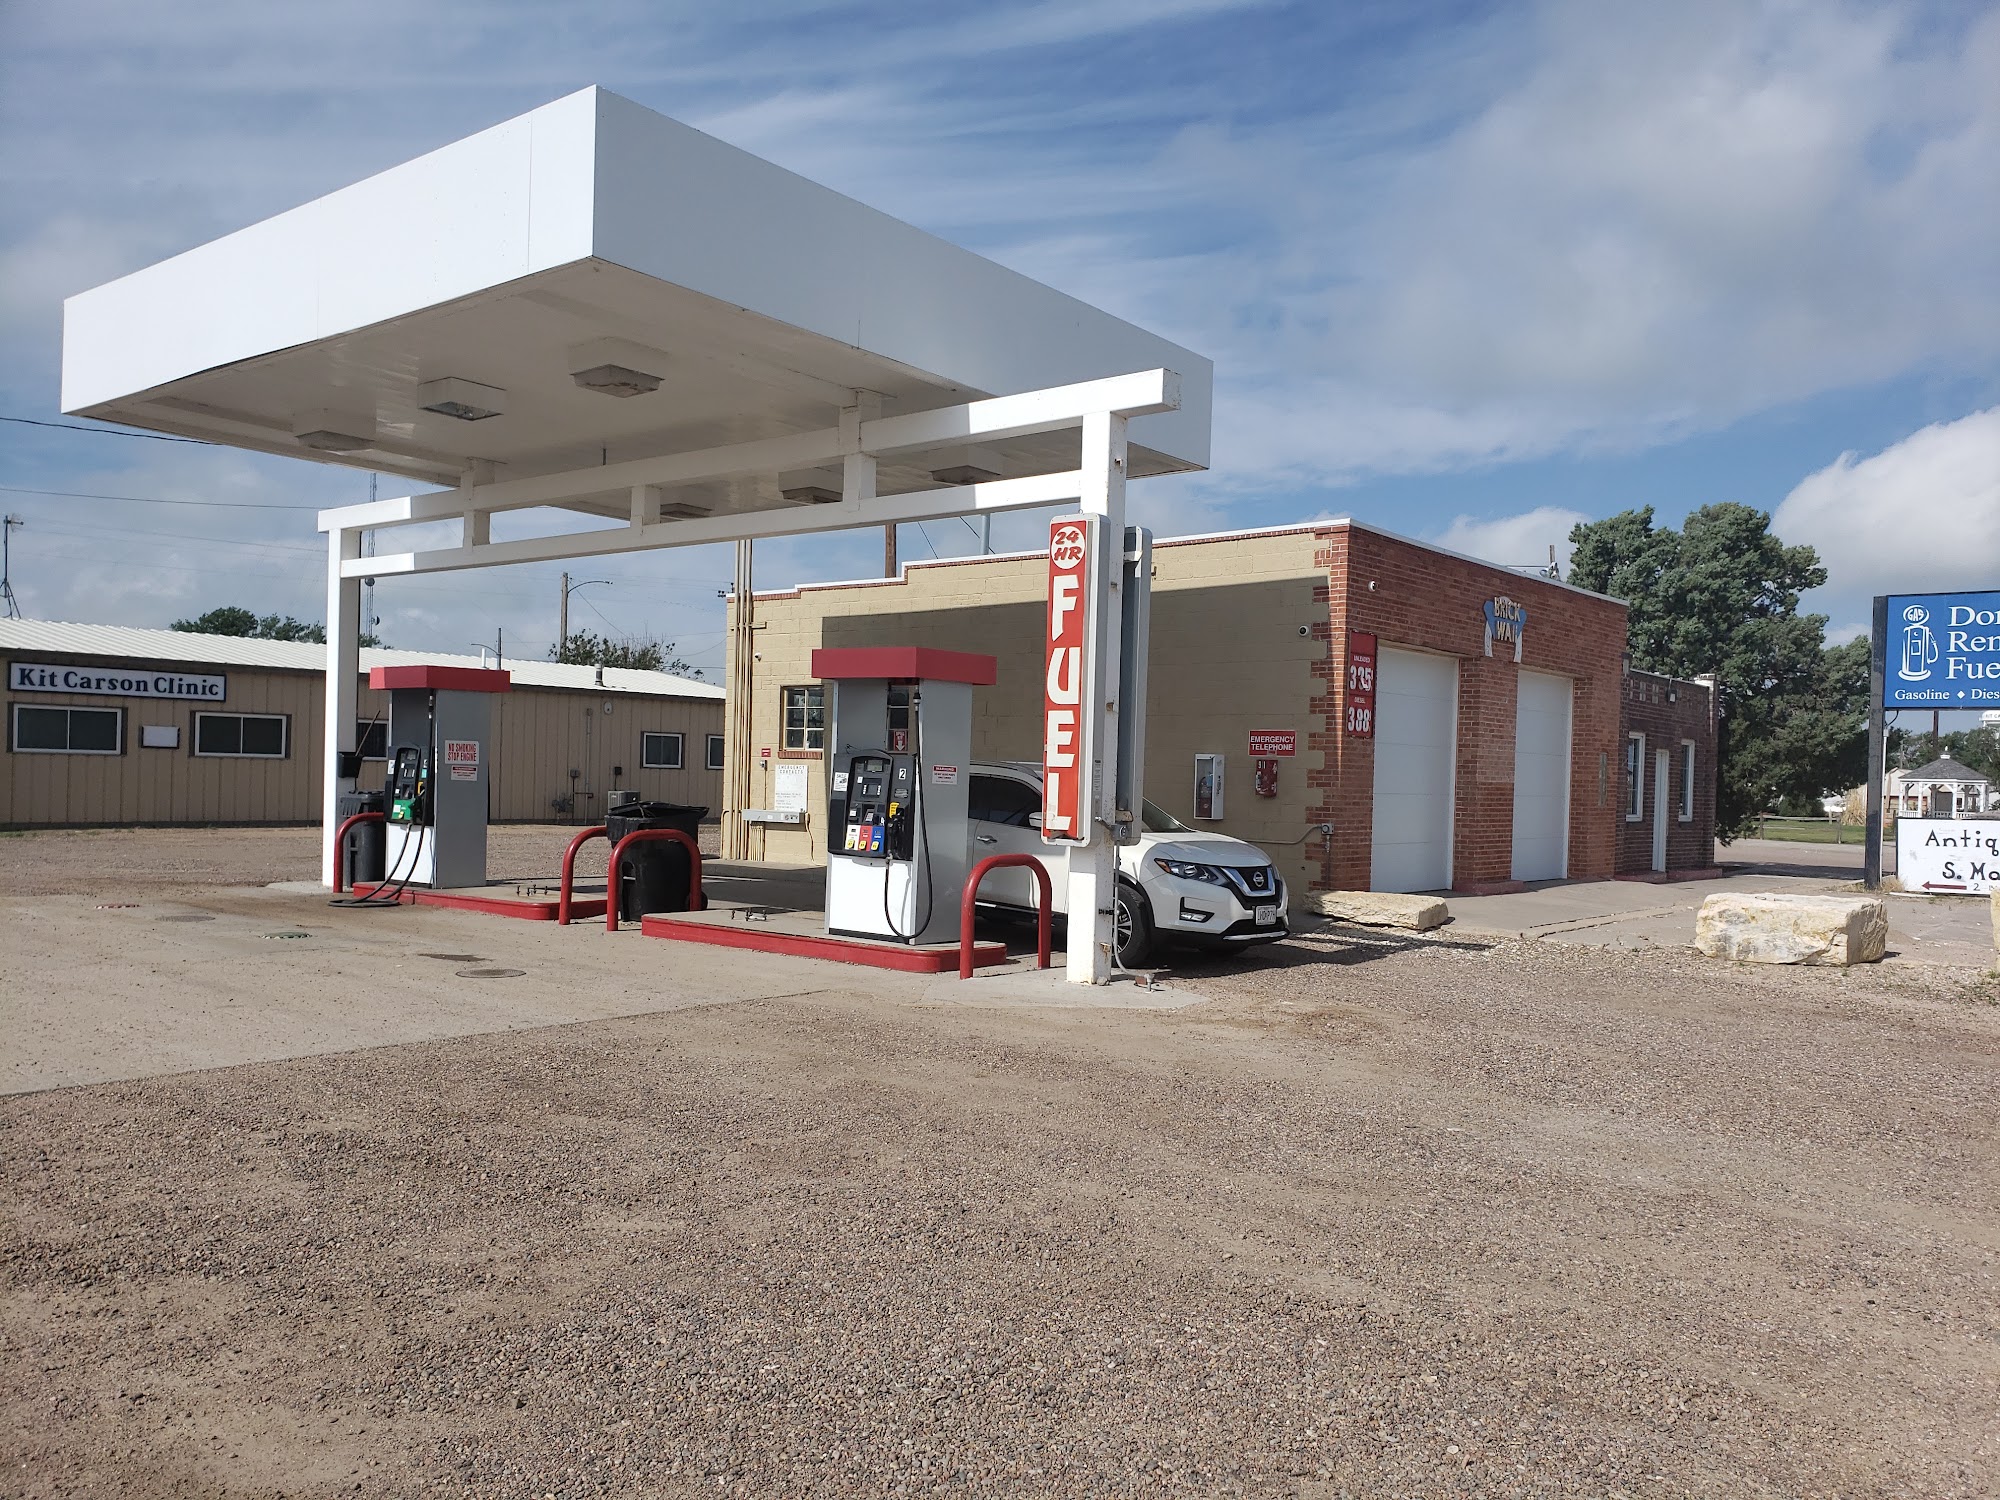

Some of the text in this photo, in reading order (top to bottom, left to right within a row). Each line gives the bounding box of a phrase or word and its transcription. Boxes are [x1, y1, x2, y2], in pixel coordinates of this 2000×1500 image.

[1054, 530, 1080, 545] 24
[1053, 545, 1082, 561] HR
[1494, 596, 1521, 622] BRICK
[1907, 607, 1925, 622] GAS
[18, 667, 219, 696] Kit Carson Clinic
[1894, 688, 1950, 700] Gasoline
[1046, 574, 1081, 831] FUEL
[1250, 735, 1295, 743] EMERGENCY
[456, 744, 476, 752] SMOKING
[1251, 743, 1294, 751] TELEPHONE
[448, 752, 476, 761] STOP ENGINE
[900, 769, 906, 779] 2
[1942, 861, 1962, 880] S.
